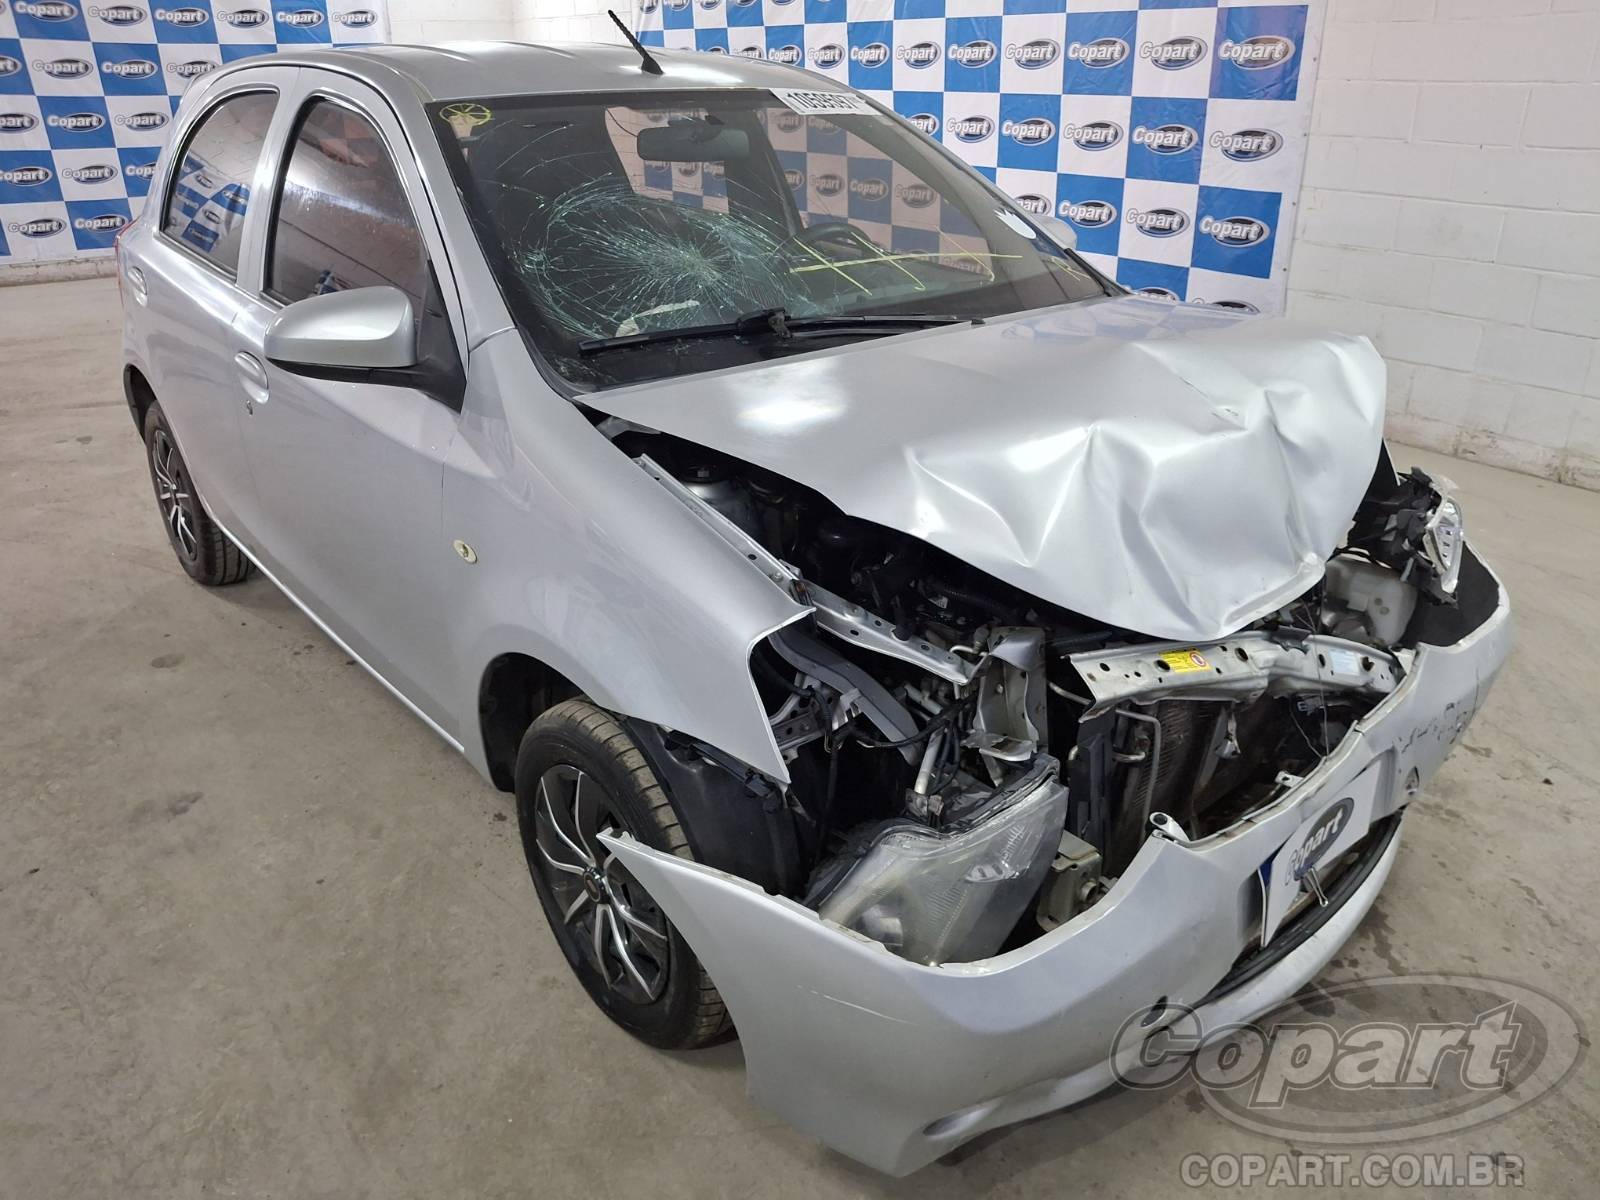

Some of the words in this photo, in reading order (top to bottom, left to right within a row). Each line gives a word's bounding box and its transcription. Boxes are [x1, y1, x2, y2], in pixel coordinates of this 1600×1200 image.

[16, 1, 70, 17] Copart
[88, 6, 140, 22] Copart
[156, 10, 203, 25] Copart
[217, 11, 262, 24] Copart
[276, 12, 318, 25] Copart
[332, 12, 373, 25] Copart
[808, 48, 840, 62] Copart
[851, 46, 884, 63] Copart
[896, 46, 936, 63] Copart
[948, 44, 992, 63] Copart
[1005, 43, 1053, 62] Copart
[1067, 42, 1122, 64] Copart
[1139, 41, 1201, 63] Copart
[1218, 40, 1288, 64] Copart
[32, 60, 85, 75] Copart
[102, 62, 151, 75] Copart
[0, 116, 31, 129] part
[48, 115, 100, 128] Copart
[115, 114, 162, 126] Copart
[947, 119, 990, 135] Copart
[1002, 120, 1050, 139] Copart
[1064, 123, 1116, 144] Copart
[1133, 126, 1193, 148] Copart
[1210, 130, 1274, 154] Copart
[62, 168, 111, 181] Copart
[850, 180, 884, 196] Copart
[1058, 201, 1111, 221] Copart
[1126, 208, 1183, 230] Copart
[8, 220, 59, 234] Copart
[75, 217, 122, 231] Copart
[1200, 215, 1261, 240] Copart
[1284, 807, 1344, 886] Copart
